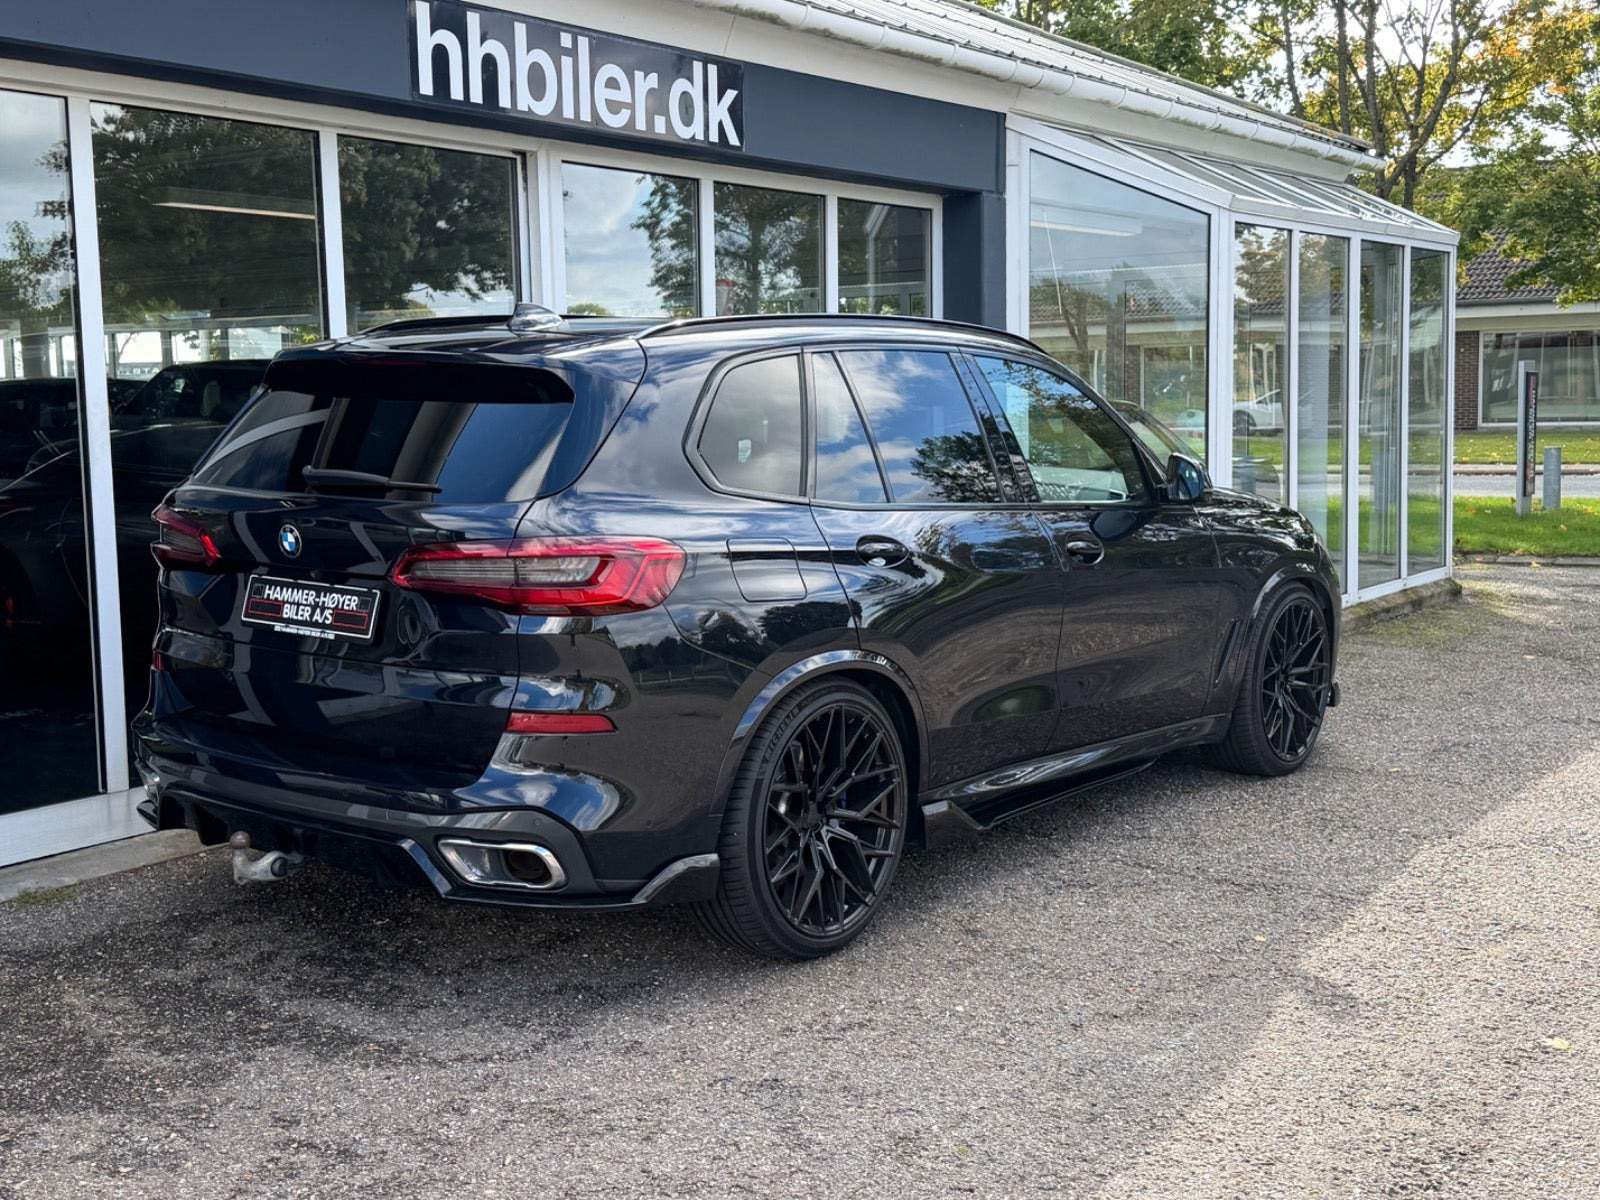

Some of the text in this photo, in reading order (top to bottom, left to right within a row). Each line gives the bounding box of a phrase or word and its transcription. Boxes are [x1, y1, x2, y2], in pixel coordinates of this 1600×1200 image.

[415, 0, 741, 147] hhbiler.dk
[263, 584, 359, 611] HAMMER-HØYER
[282, 603, 333, 624] BILER A/S
